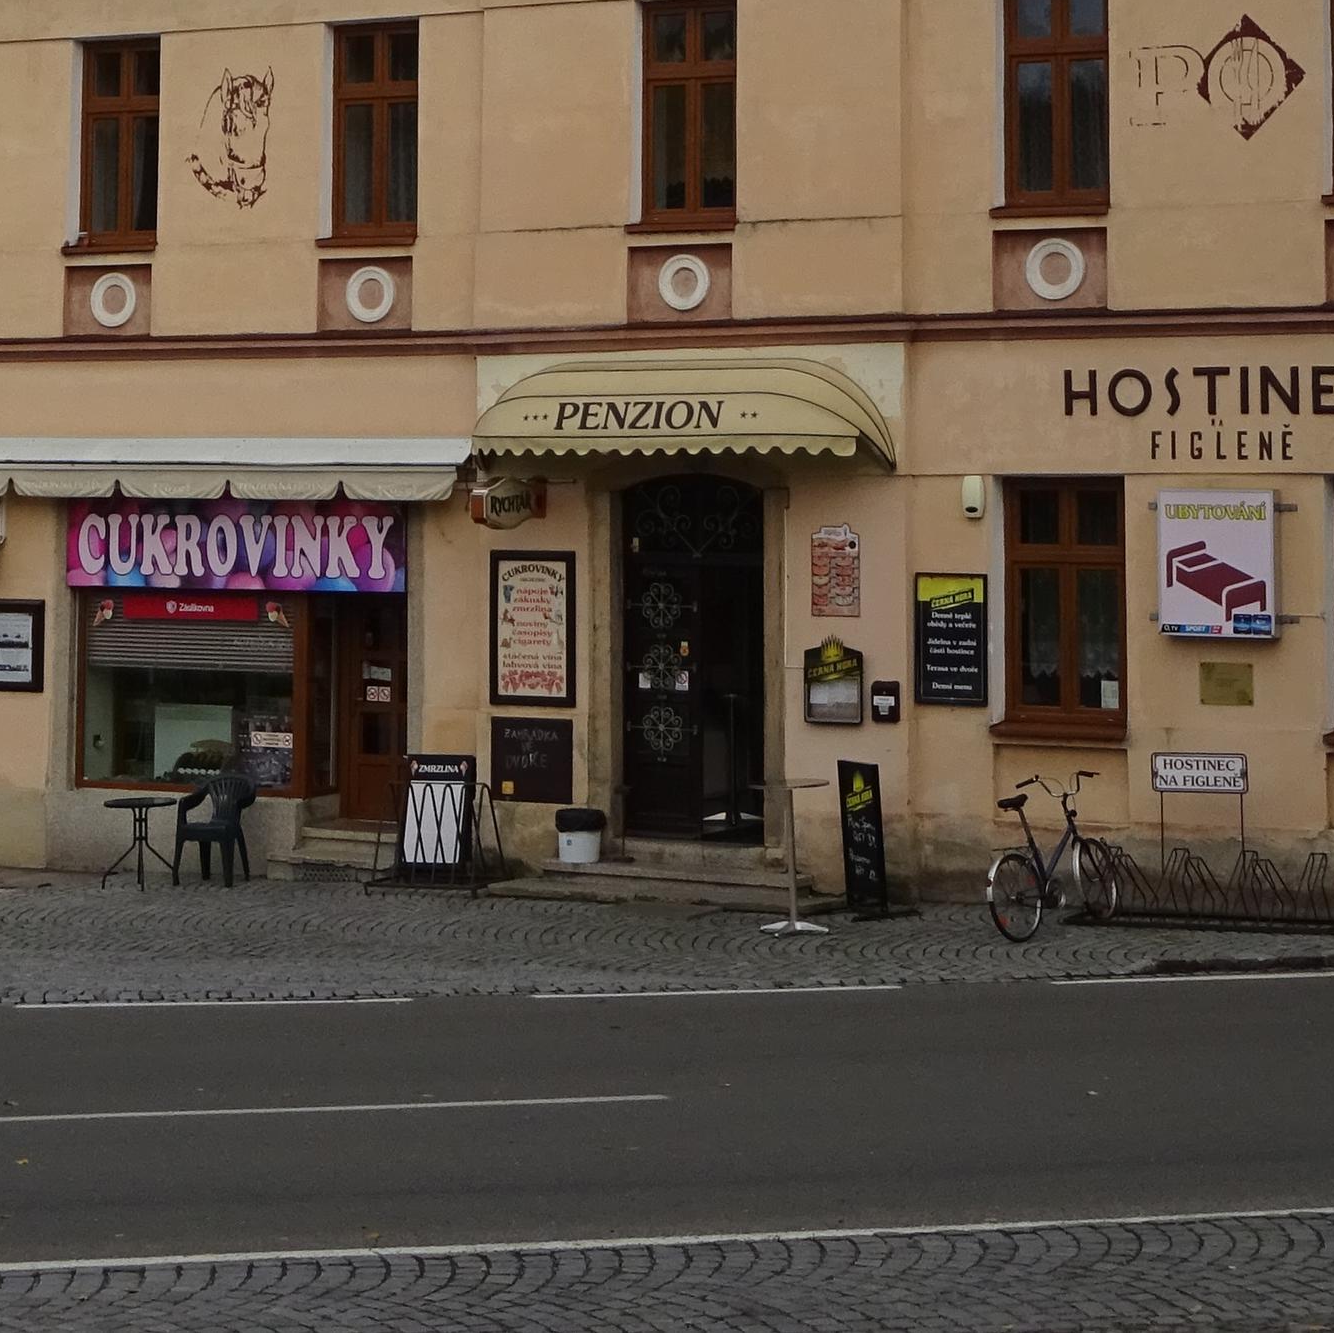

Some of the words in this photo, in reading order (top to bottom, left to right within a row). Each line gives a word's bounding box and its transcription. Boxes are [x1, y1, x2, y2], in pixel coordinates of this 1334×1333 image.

[553, 399, 724, 432] PENZION
[1150, 423, 1294, 460] FIGLENĚ
[1165, 501, 1267, 520] UBYTOVÁNÍ
[78, 512, 395, 580] CUKROVINKY
[501, 563, 565, 583] CUKROVINKY
[418, 763, 460, 774] ZMRZLINA
[1163, 758, 1236, 771] HOSTINEC
[1159, 775, 1178, 786] NA
[1182, 772, 1242, 787] FIGLENĚ
